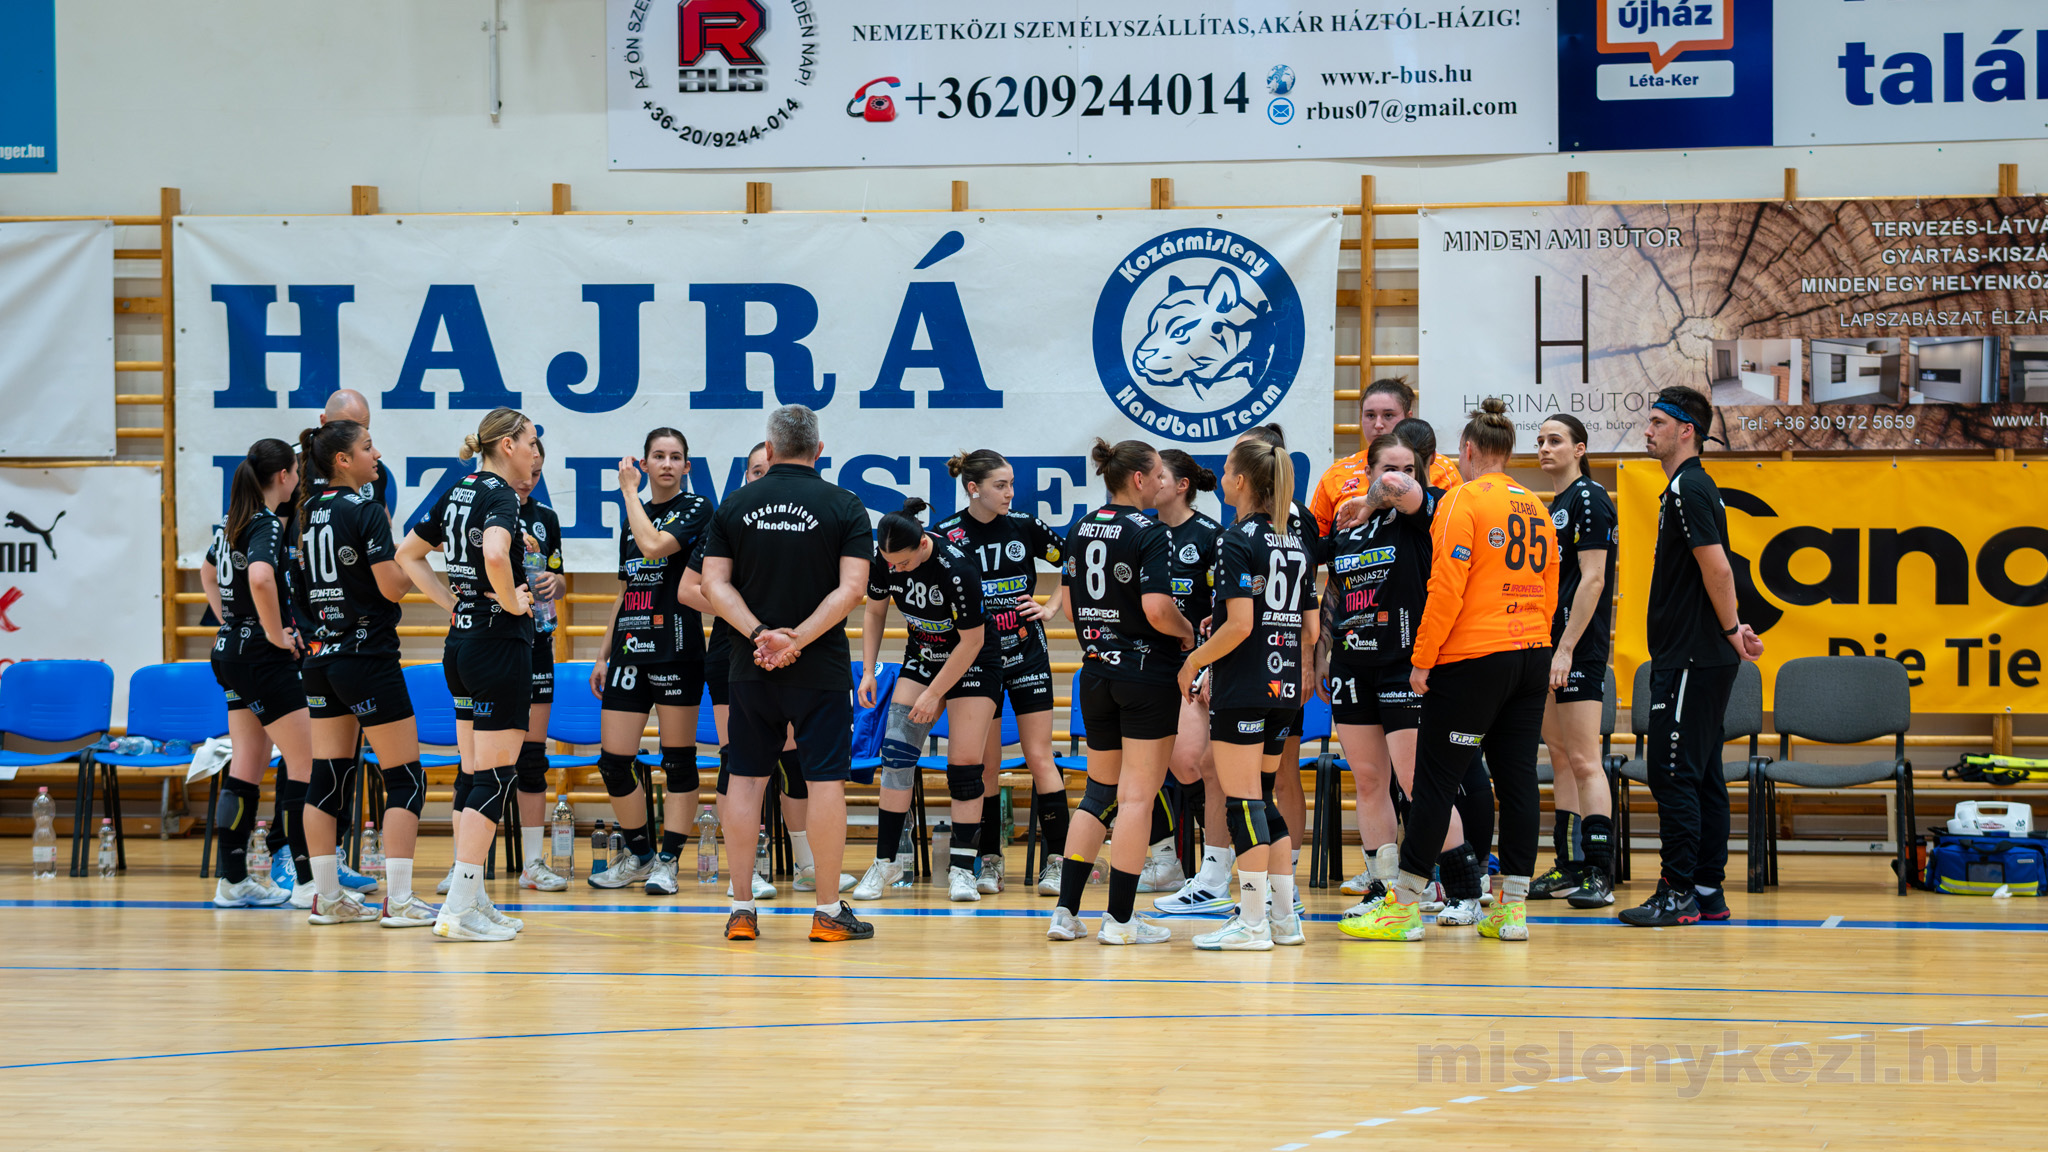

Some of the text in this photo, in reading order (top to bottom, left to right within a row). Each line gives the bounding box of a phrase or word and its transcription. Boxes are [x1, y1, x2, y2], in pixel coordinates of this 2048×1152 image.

[852, 19, 1007, 42] NEMZETKÖZI
[1332, 8, 1520, 32] HÁZTÓL-HÁZIG!
[1618, 0, 1713, 34] újház
[624, 38, 640, 63] ÖN
[794, 43, 816, 86] NAP!
[630, 67, 649, 89] AZ
[679, 68, 764, 93] BUS
[1321, 64, 1472, 86] www.r-bus.hu
[1629, 74, 1699, 88] Léta-Ker
[905, 71, 1250, 119] +36209244014
[643, 98, 799, 148] +36-20/9244-014
[1306, 98, 1518, 123] rbus07@gmail.com
[1443, 224, 1683, 251] MINDEN AMI BÚTOR
[1118, 231, 1270, 283] Kozármisleny
[1801, 276, 1880, 293] MINDEN
[1885, 275, 1927, 292] EGY
[211, 230, 1004, 414] HAJRÁ
[1840, 309, 1987, 327] LAPSZABÁSZAT,
[1115, 384, 1282, 438] Handball Team
[1606, 420, 1637, 430] bútor
[1737, 415, 1915, 431] Tel: +36 30 972 5659
[743, 502, 819, 530] Kozármisleny
[1510, 500, 1537, 516] SZABÓ
[442, 503, 472, 563] 37
[757, 520, 805, 532] Handball
[1078, 523, 1122, 540] BRETTNER
[302, 524, 338, 583] 10
[1505, 513, 1547, 573] 85
[975, 543, 1001, 572] 17
[1085, 540, 1107, 600] 8
[905, 578, 927, 609] 28
[1265, 549, 1307, 611] 67
[1945, 632, 2042, 687] Tie
[612, 665, 638, 690] 18
[1332, 677, 1358, 704] 21
